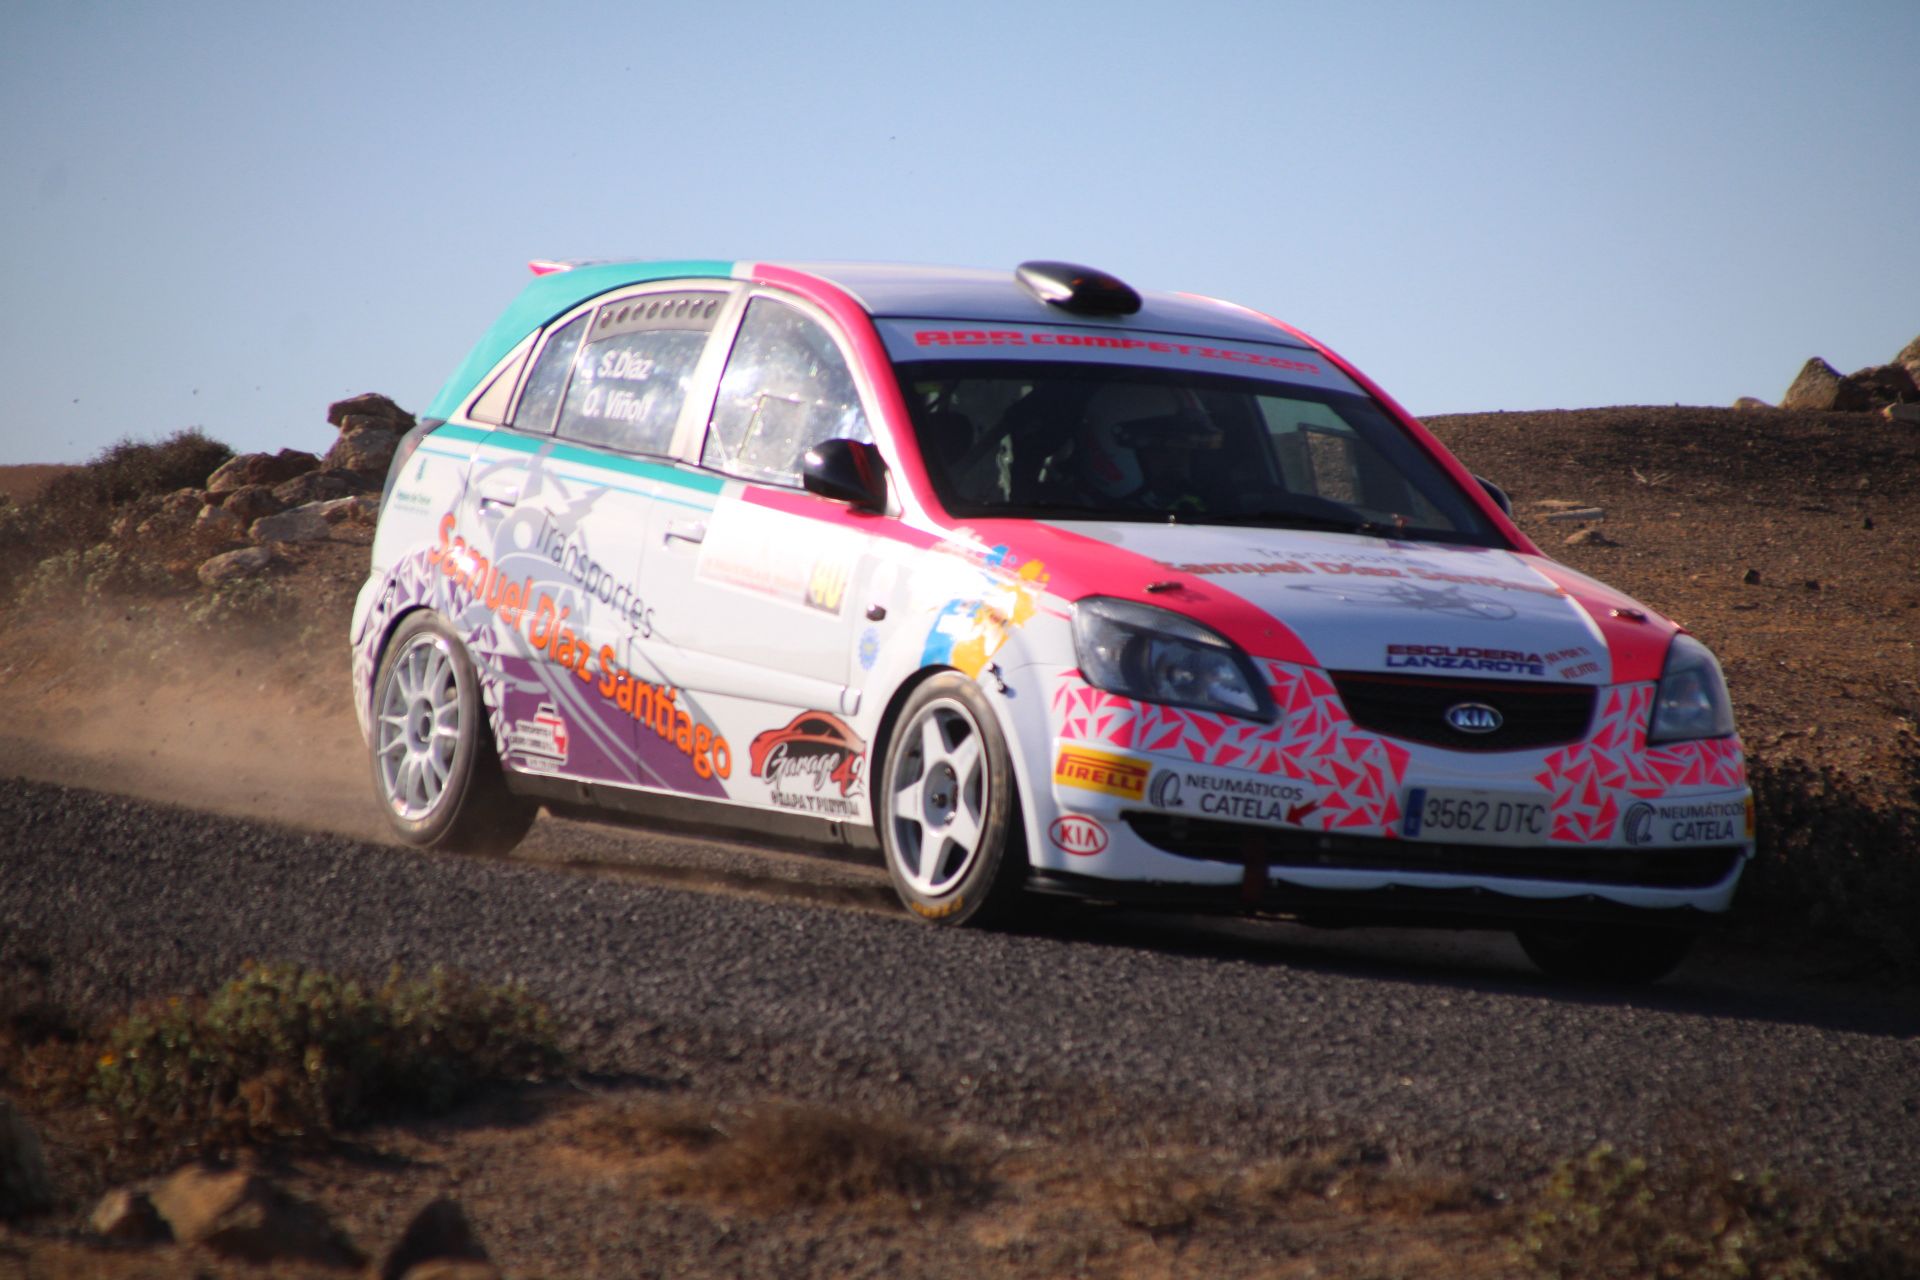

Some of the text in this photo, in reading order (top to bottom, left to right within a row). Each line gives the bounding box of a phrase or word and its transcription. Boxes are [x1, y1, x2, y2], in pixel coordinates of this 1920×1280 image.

[914, 331, 1027, 346] ADR
[536, 508, 655, 638] Transportes
[427, 512, 732, 779] Samuel Díaz Santiago
[1387, 644, 1543, 662] ESCUDERIA
[1386, 656, 1544, 676] LANZAROTE
[1457, 709, 1496, 727] KIA
[762, 741, 841, 791] Garage
[1056, 752, 1149, 793] PIRELLI
[1185, 773, 1303, 800] NEUMÁTICOS
[1201, 793, 1283, 822] CATELA
[1423, 797, 1490, 832] 3562
[1494, 801, 1545, 834] DTC
[1658, 801, 1745, 819] NEUMÁTICOS
[1059, 823, 1100, 850] KIA
[1672, 819, 1735, 842] CATELA
